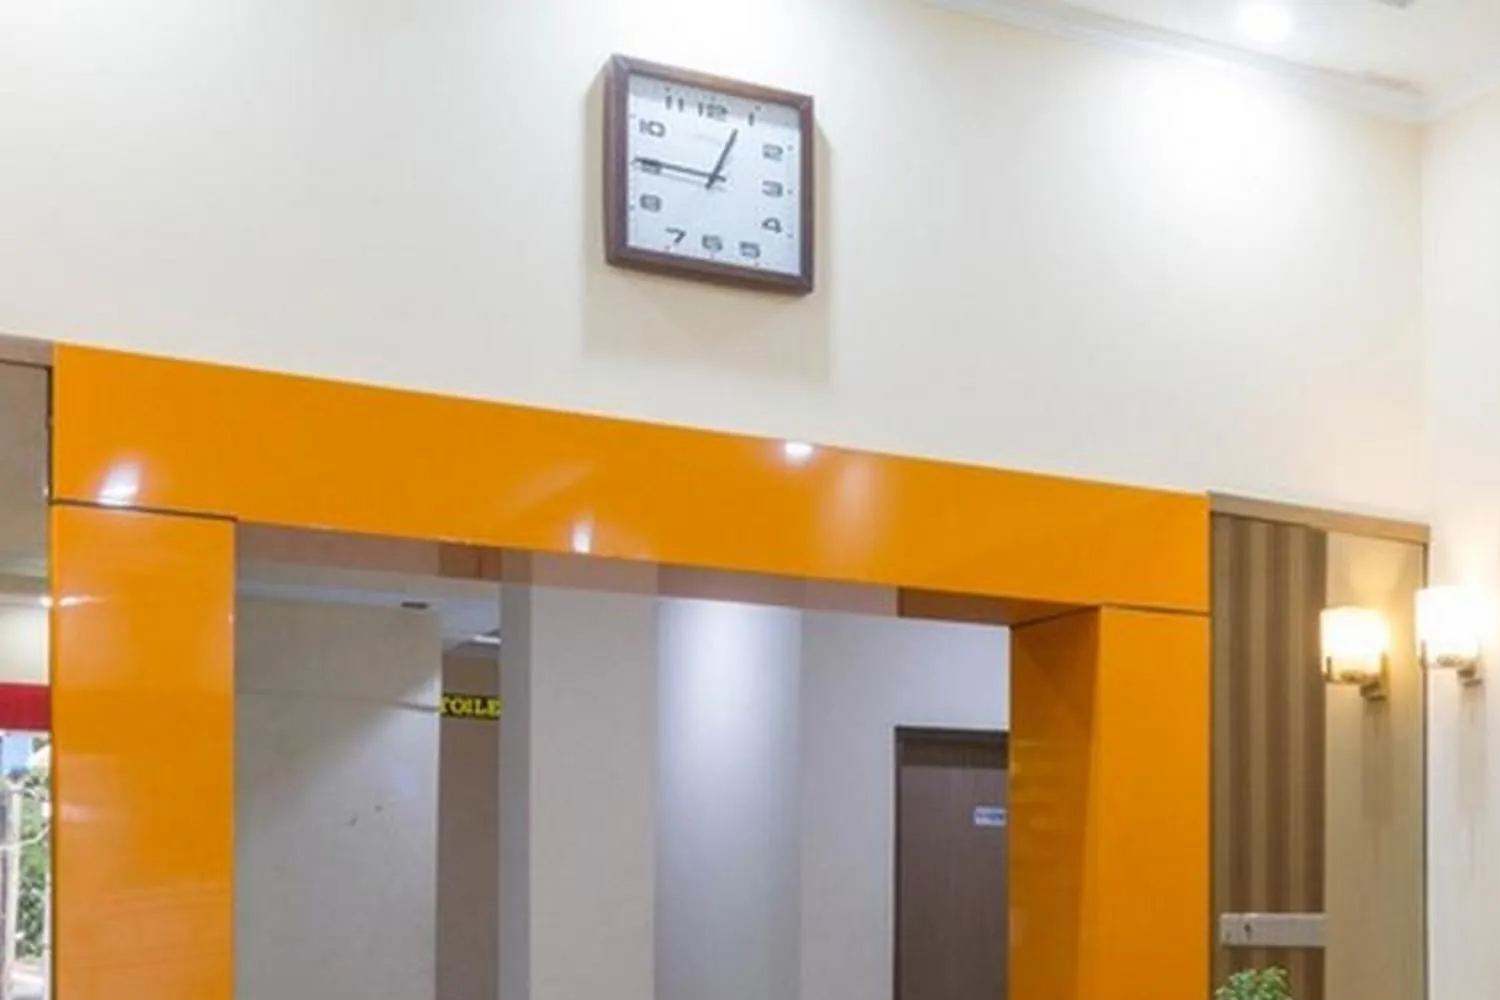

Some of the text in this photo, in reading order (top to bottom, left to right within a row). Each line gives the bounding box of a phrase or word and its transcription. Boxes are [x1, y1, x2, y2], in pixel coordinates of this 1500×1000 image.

[664, 94, 685, 113] 11
[697, 102, 728, 121] 12
[639, 118, 666, 138] 10
[762, 143, 783, 162] 2
[762, 181, 783, 198] 3
[665, 227, 687, 244] 7
[761, 217, 783, 235] 4
[701, 234, 723, 253] 6
